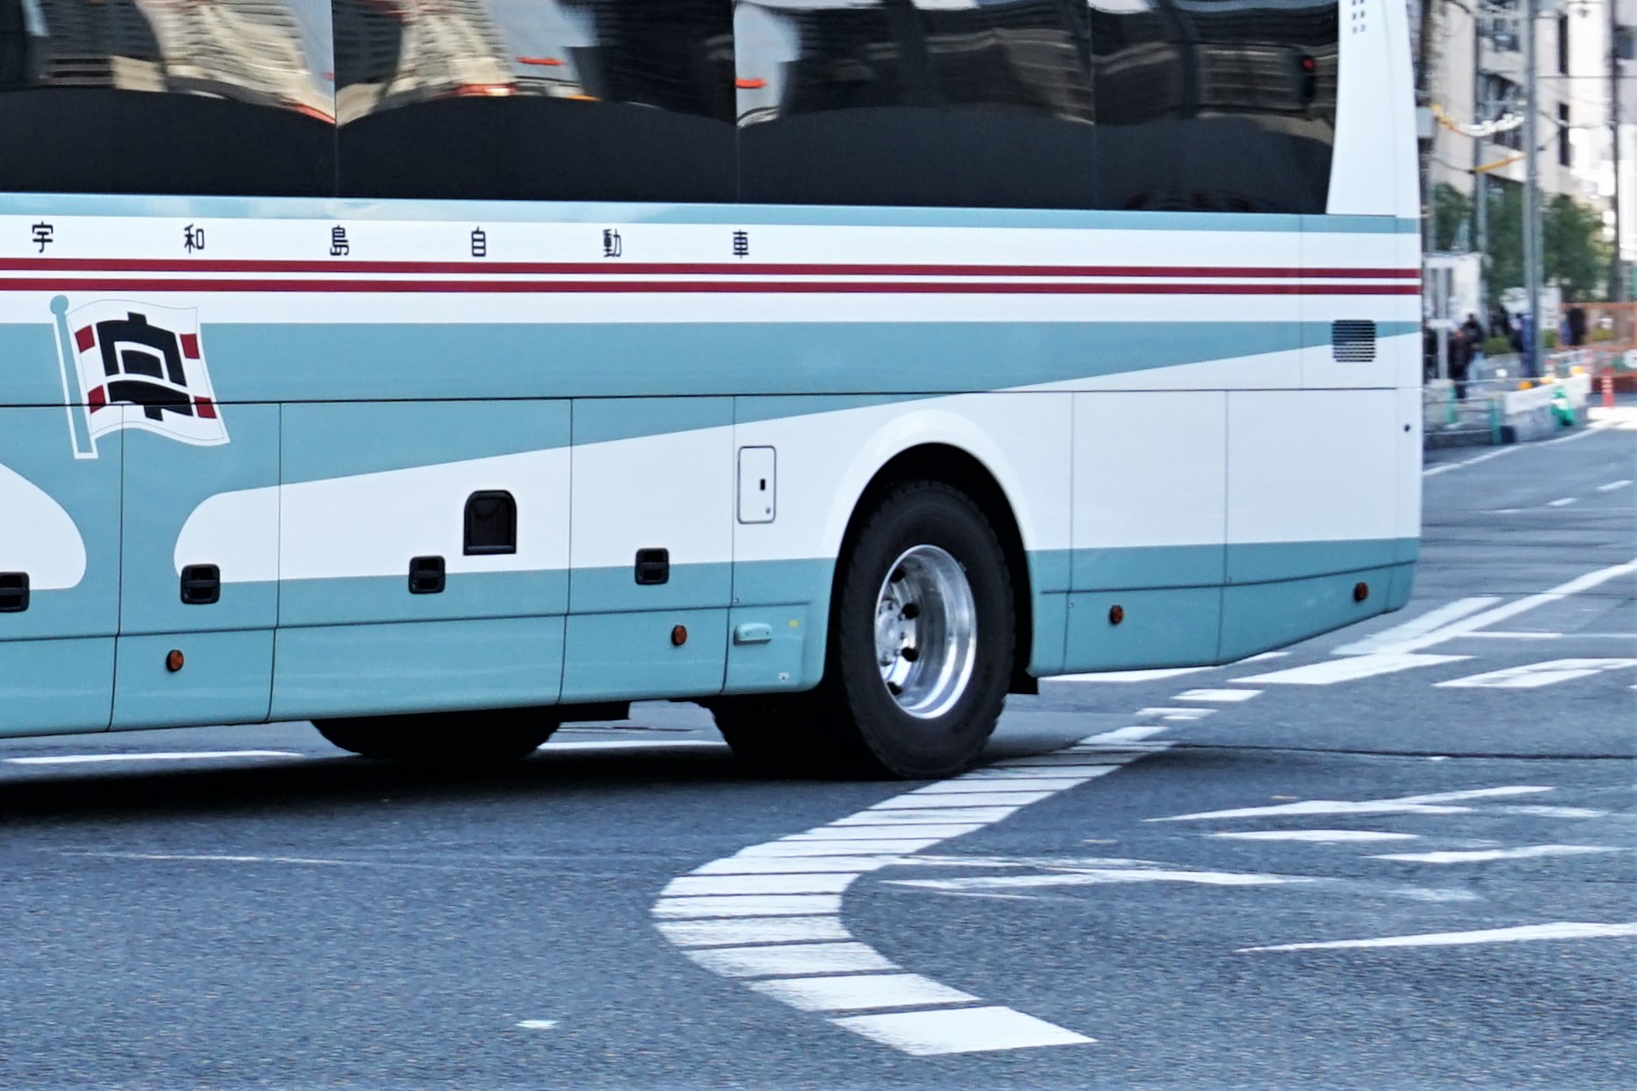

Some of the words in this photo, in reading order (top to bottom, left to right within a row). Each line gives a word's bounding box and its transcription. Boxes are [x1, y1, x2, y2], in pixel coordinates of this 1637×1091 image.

[32, 221, 749, 259] 宇和島自動車
